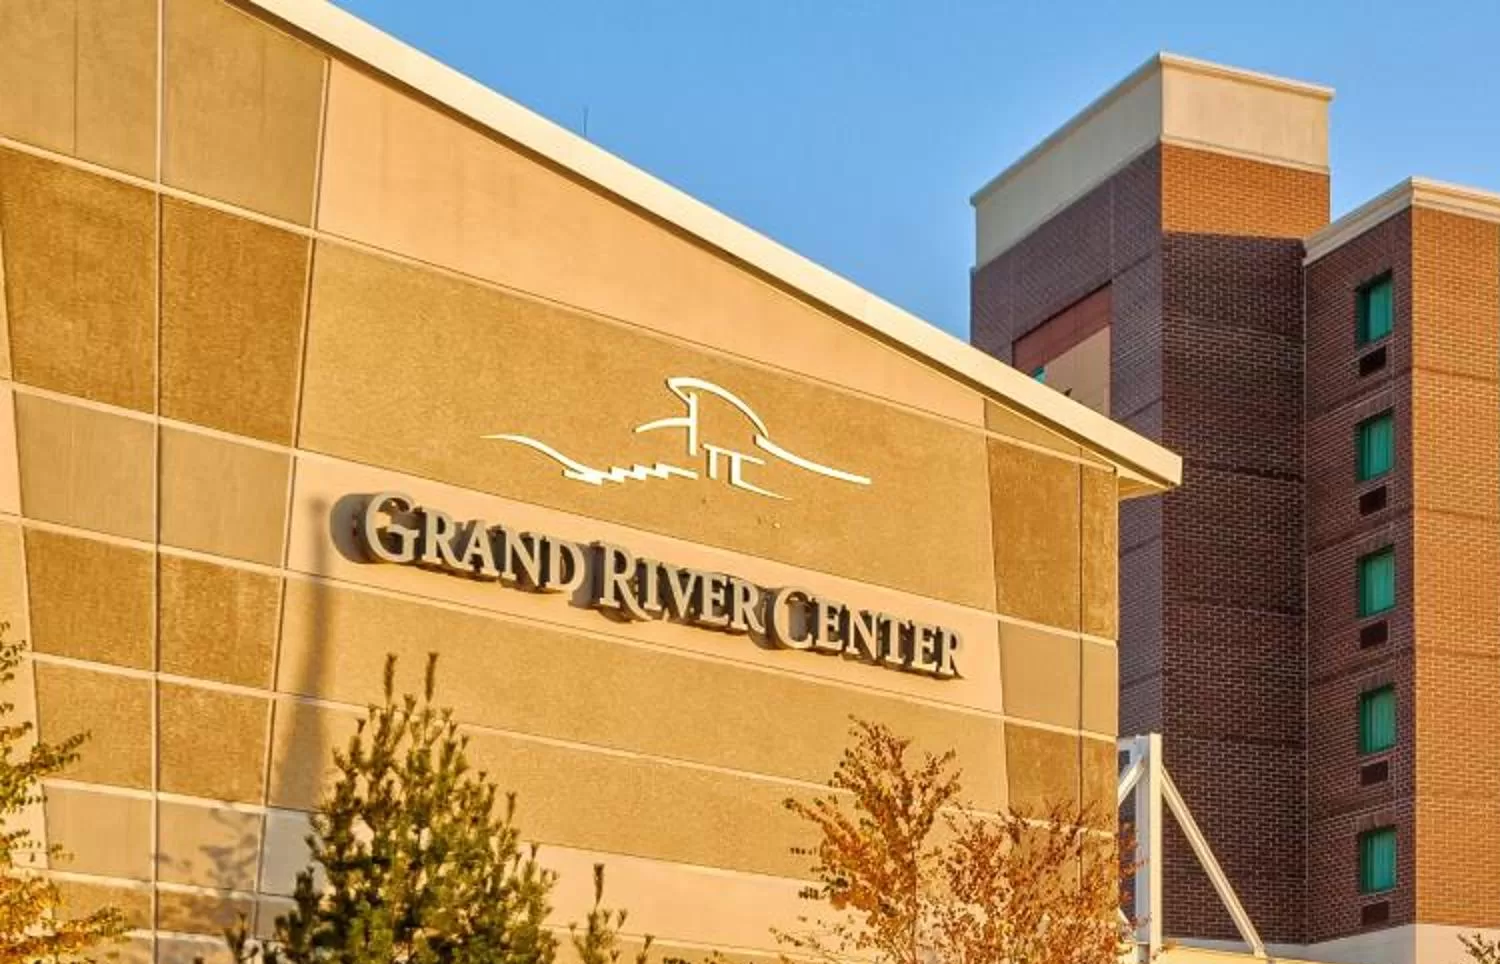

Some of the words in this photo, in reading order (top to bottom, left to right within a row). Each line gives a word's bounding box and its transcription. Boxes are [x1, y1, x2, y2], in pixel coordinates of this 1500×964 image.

[365, 490, 586, 592] GRAND
[598, 542, 766, 635] RIVER
[773, 586, 964, 679] CENTER
